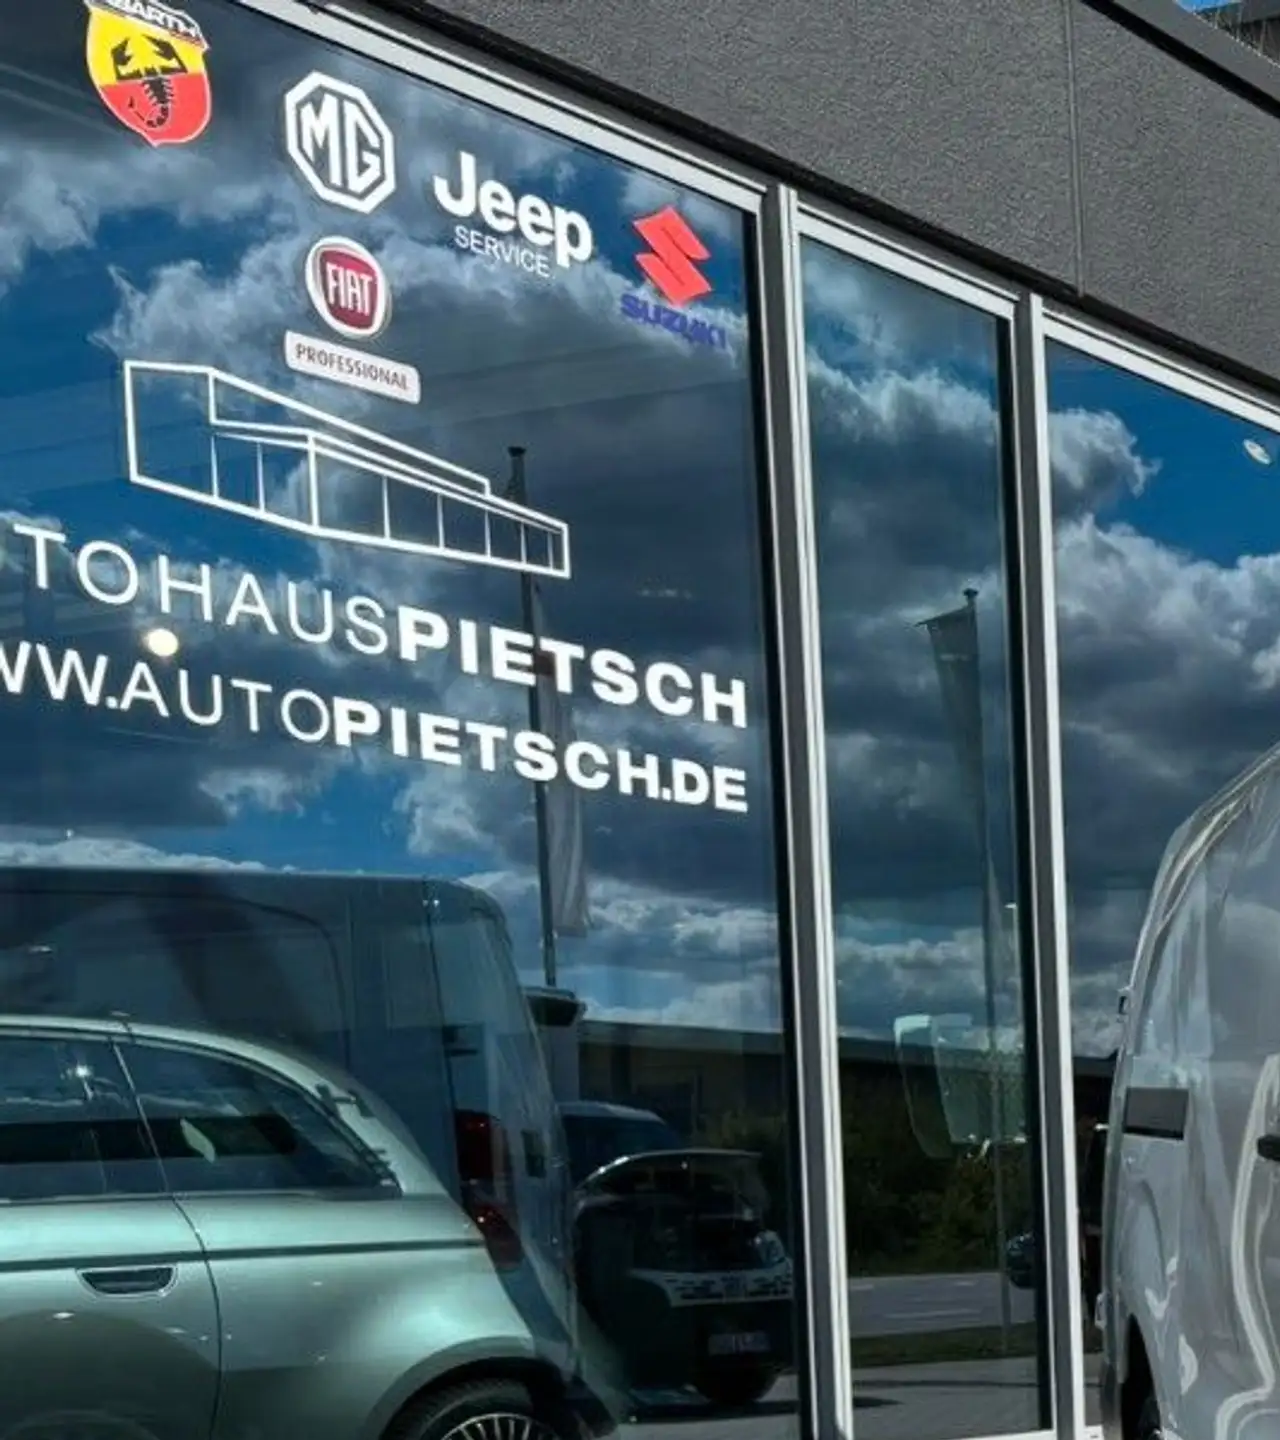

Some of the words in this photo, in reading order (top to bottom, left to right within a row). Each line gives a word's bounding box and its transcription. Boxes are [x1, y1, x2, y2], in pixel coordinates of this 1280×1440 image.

[433, 150, 593, 268] Jeep
[453, 224, 551, 279] SERVICE
[325, 261, 373, 317] FIAT
[620, 292, 727, 348] SUZUKI
[296, 342, 408, 391] PROFESSIONAL
